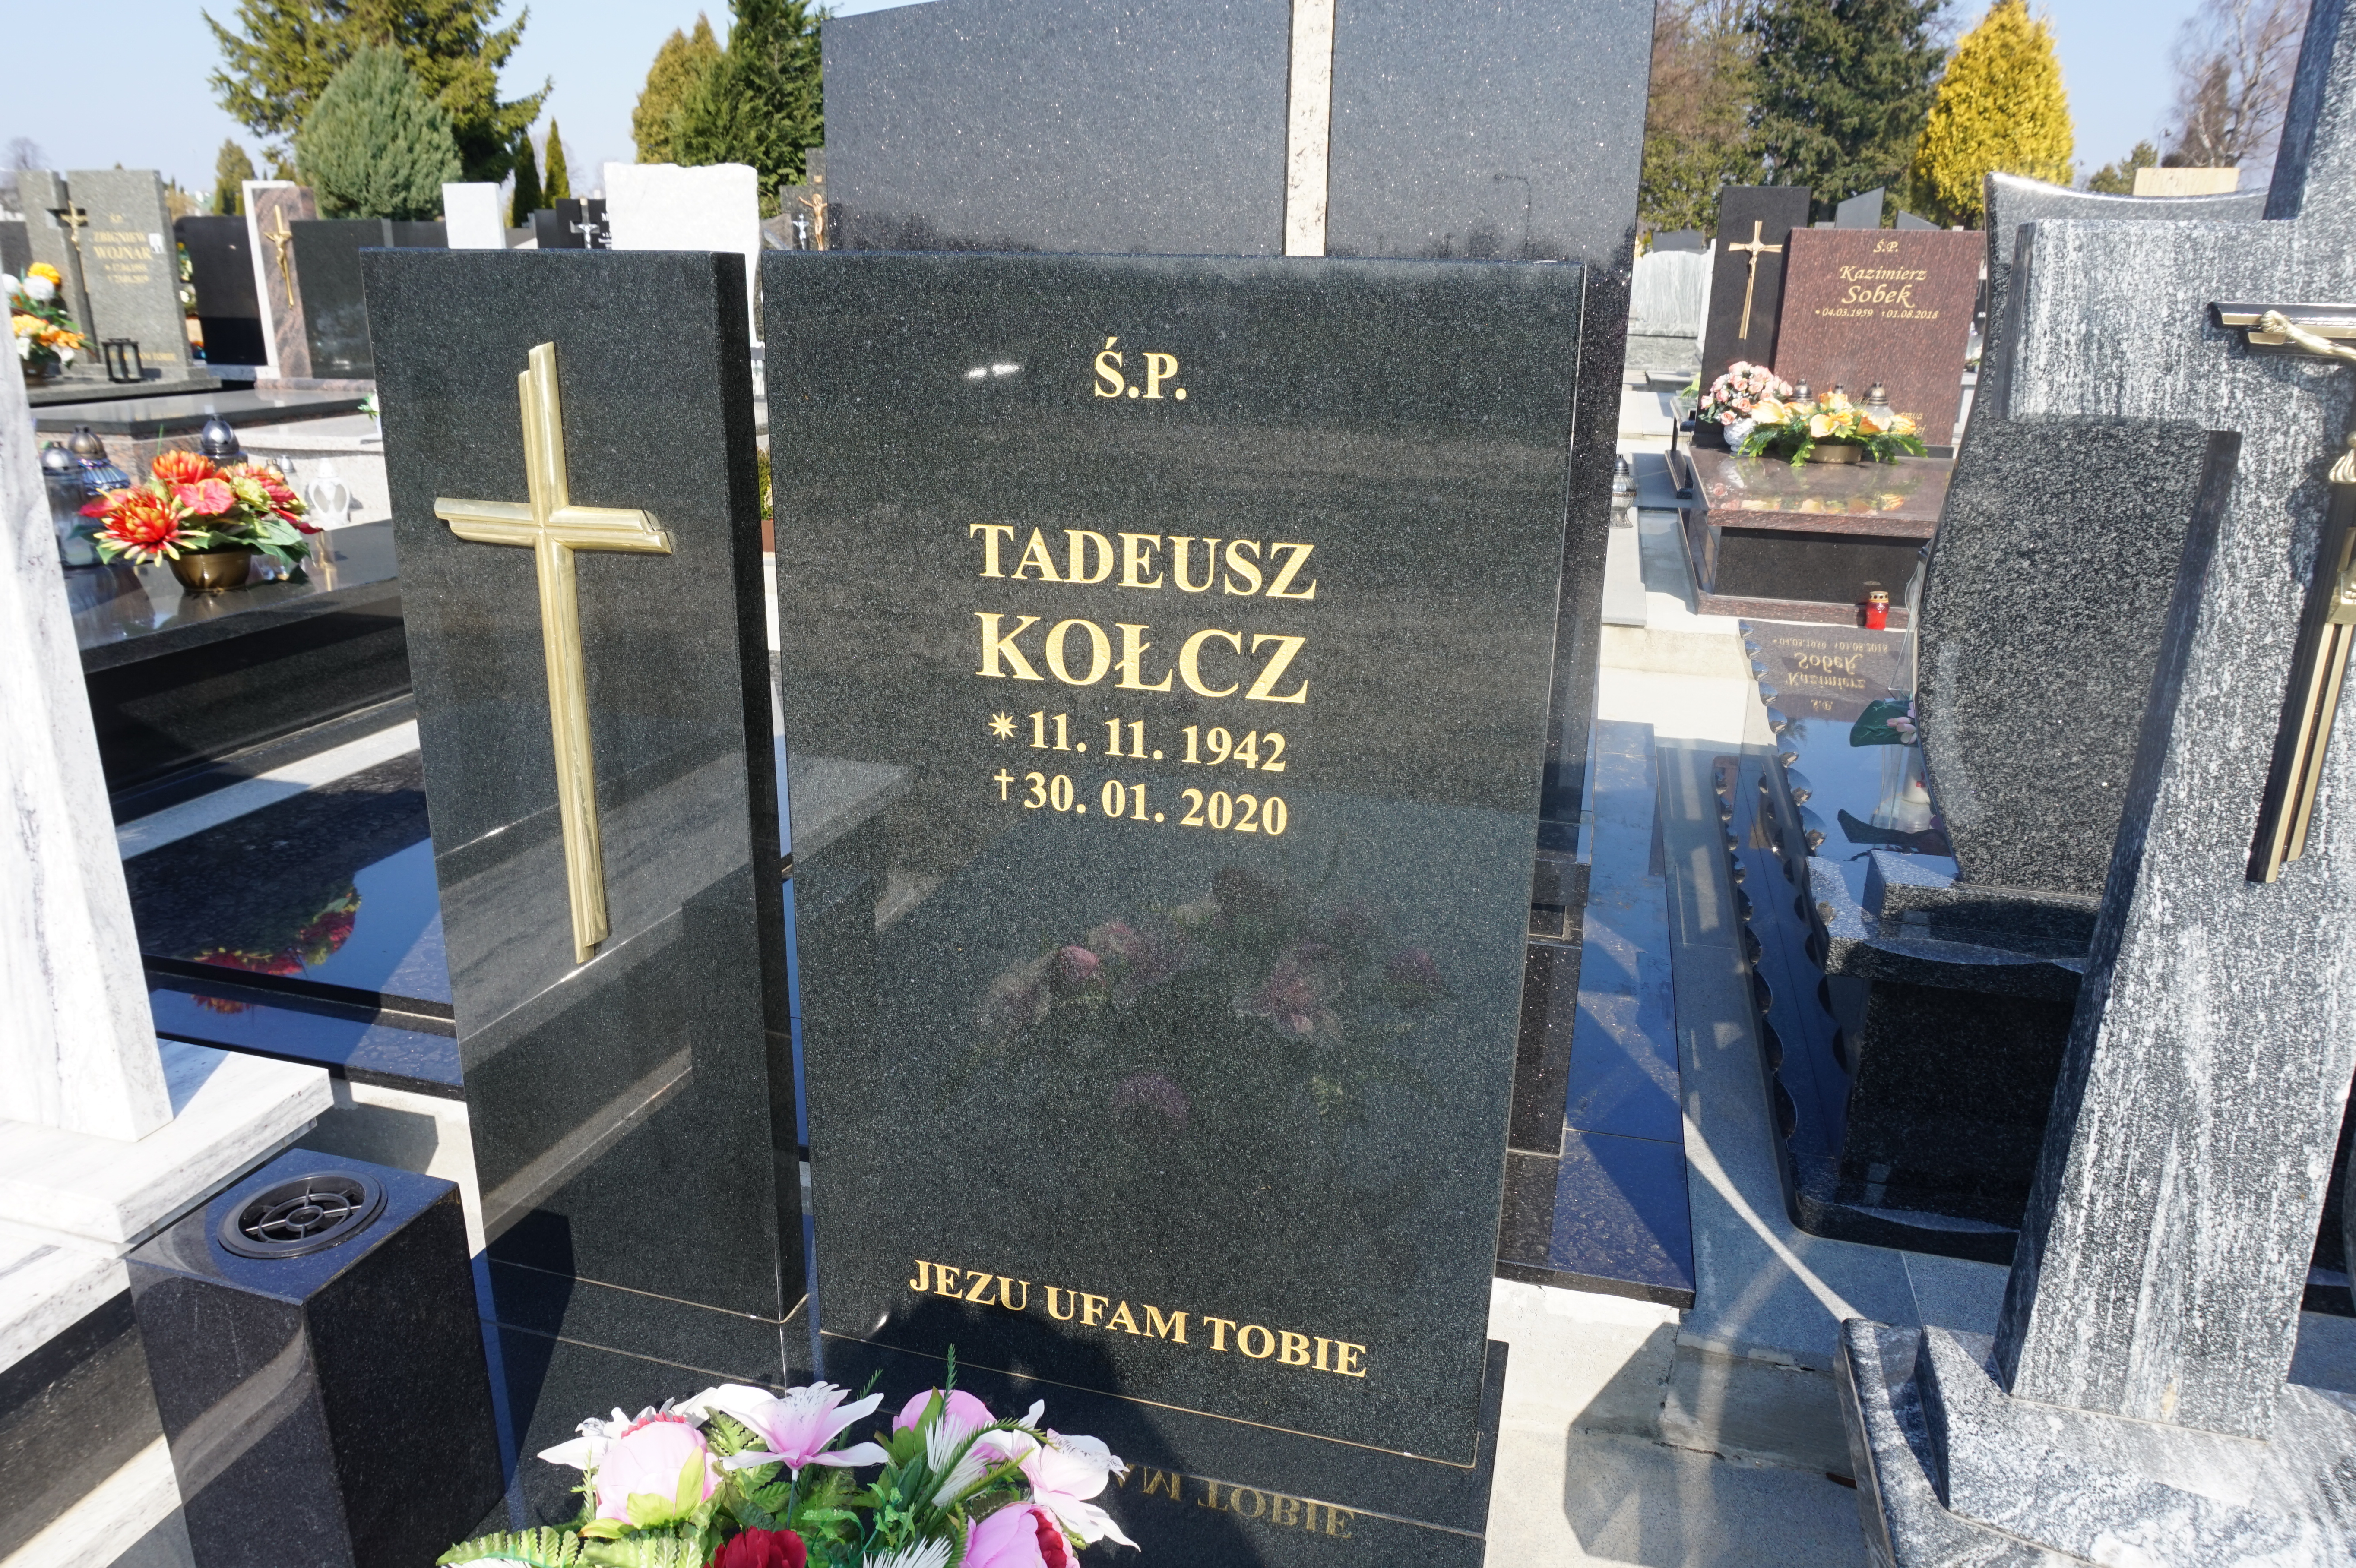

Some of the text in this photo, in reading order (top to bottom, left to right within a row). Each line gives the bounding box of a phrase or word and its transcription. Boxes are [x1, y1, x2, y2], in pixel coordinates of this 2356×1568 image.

[93, 245, 153, 260] WOJNAR
[1840, 265, 1927, 281] Kazimierz
[1873, 238, 1899, 253] Ś.P.
[1822, 308, 1939, 319] 04.03.1959 01.08.2018
[1841, 284, 1916, 308] Sobek
[1093, 336, 1187, 400] Ś.P.
[969, 523, 1317, 600] TADEUSZ
[973, 611, 1309, 705] KOŁCZ
[1029, 710, 1288, 773] 11. 11. 1942
[1023, 771, 1289, 836] 30. 01. 2020
[908, 1259, 1368, 1378] JEZU UFAM TOBIE
